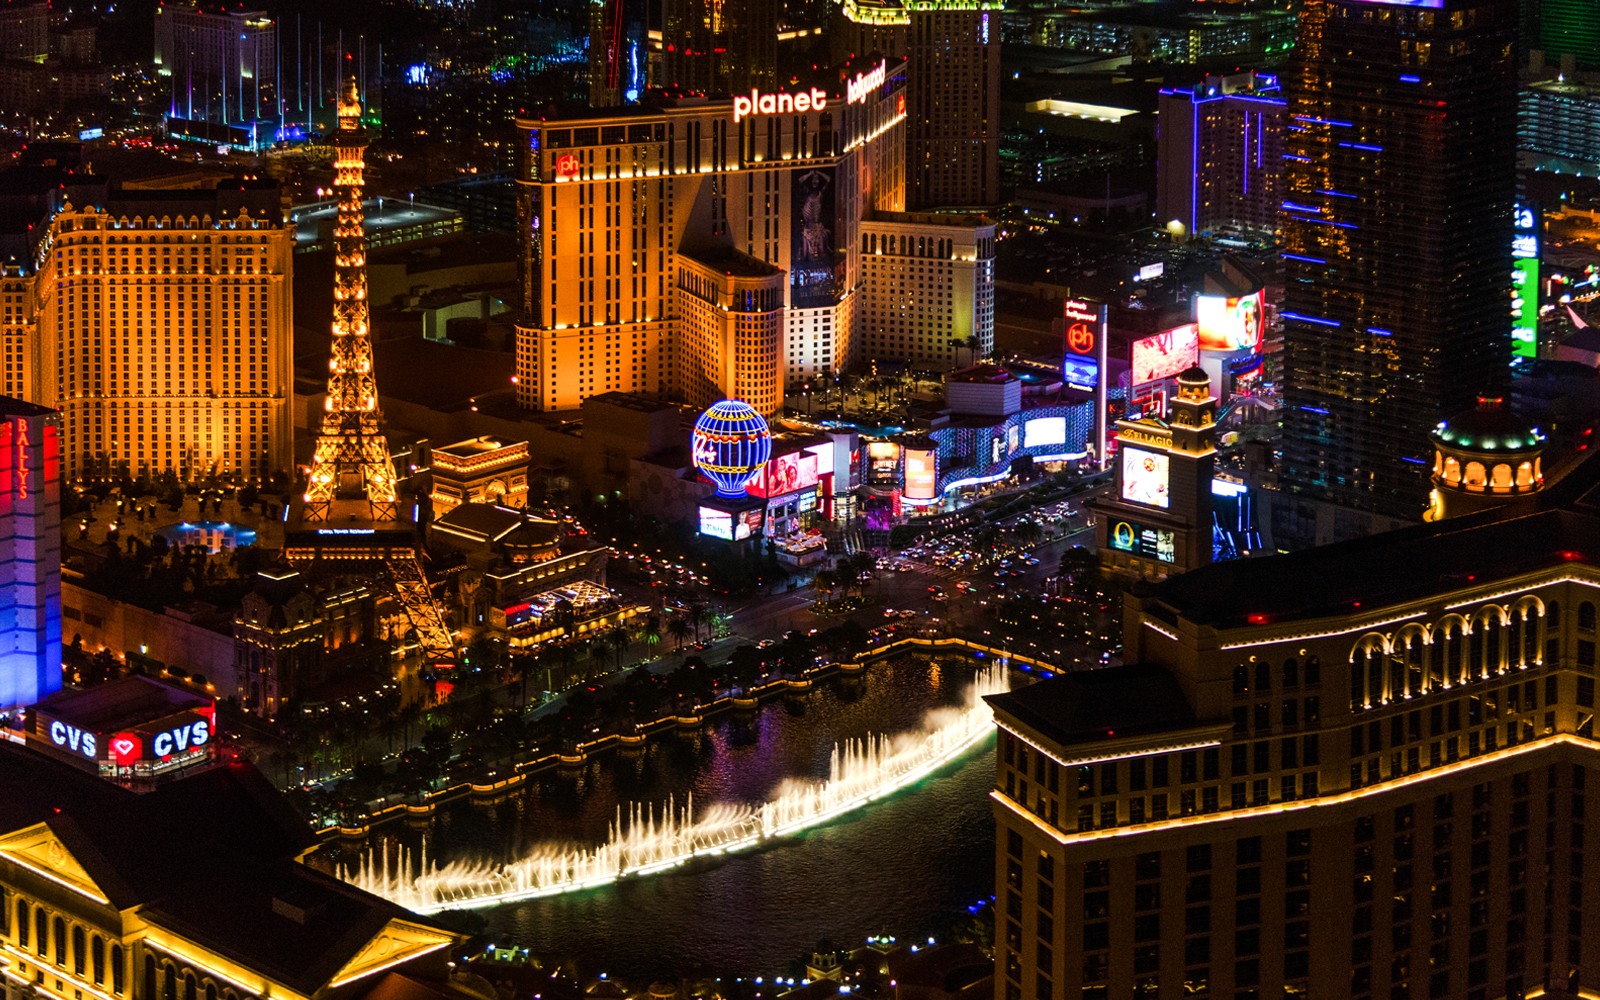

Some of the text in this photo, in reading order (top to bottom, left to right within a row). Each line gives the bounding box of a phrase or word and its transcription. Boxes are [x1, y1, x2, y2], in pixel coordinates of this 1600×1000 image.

[734, 87, 826, 123] planet
[847, 58, 886, 105] hollywood
[693, 434, 717, 468] Paris
[1122, 428, 1173, 447] BELLAGIO
[17, 418, 30, 499] BALLYS
[51, 720, 97, 758] CVS
[154, 720, 209, 757] CVS
